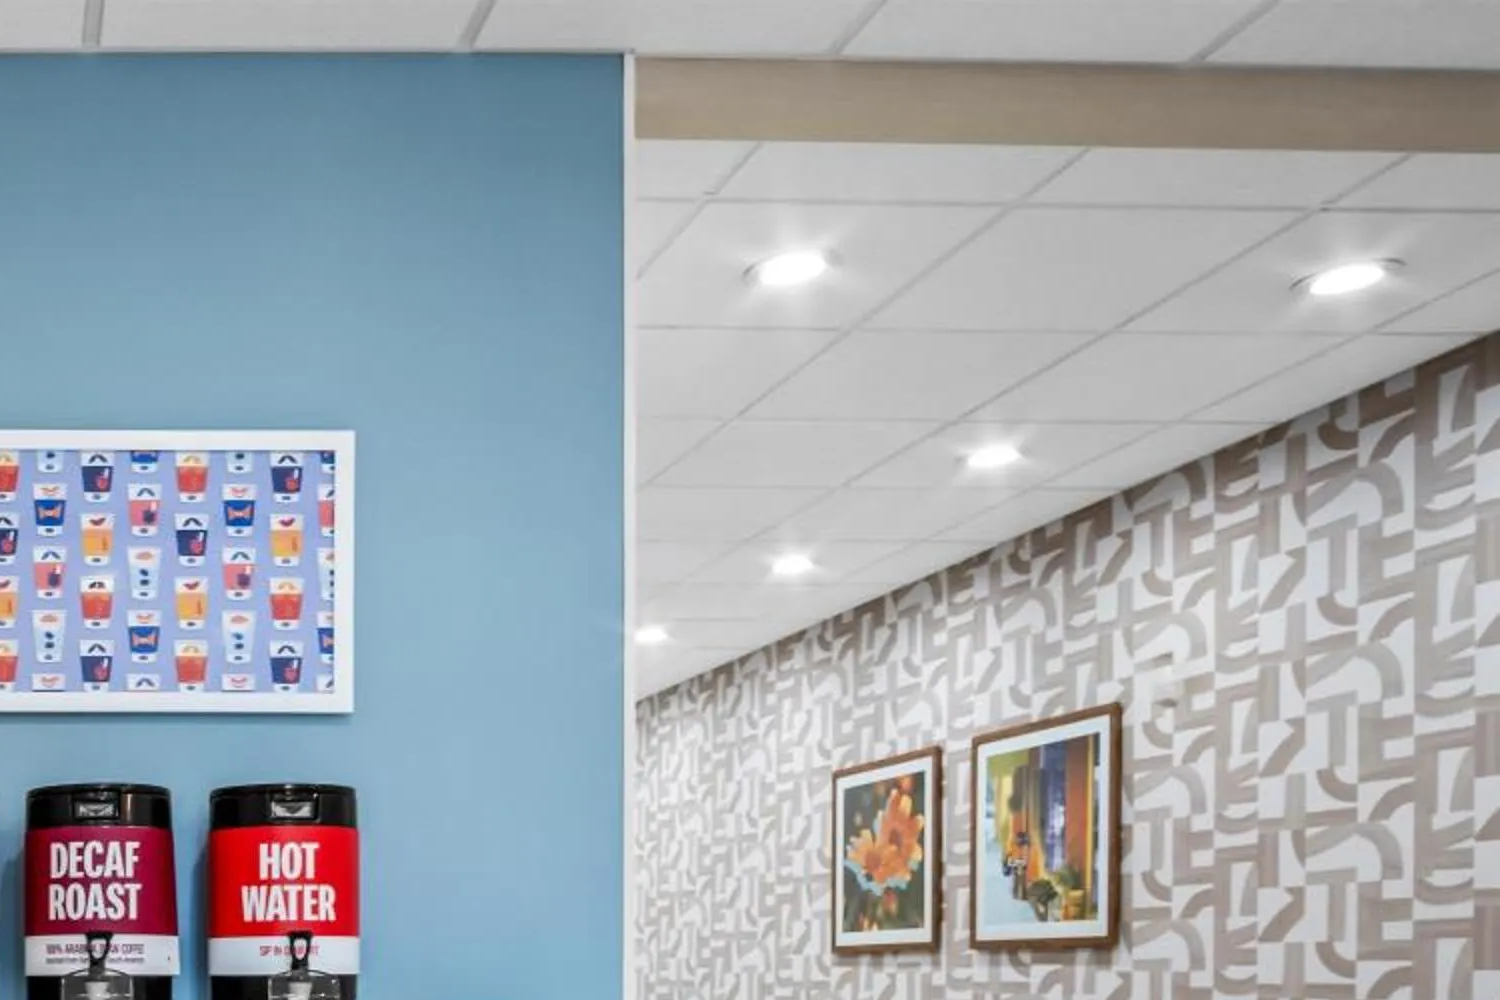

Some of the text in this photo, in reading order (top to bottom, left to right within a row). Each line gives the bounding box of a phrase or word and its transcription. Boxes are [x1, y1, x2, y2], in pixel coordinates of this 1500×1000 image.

[49, 840, 141, 879] DECAF
[259, 841, 320, 880] HOT
[48, 882, 142, 921] ROAST
[241, 884, 337, 922] WATER
